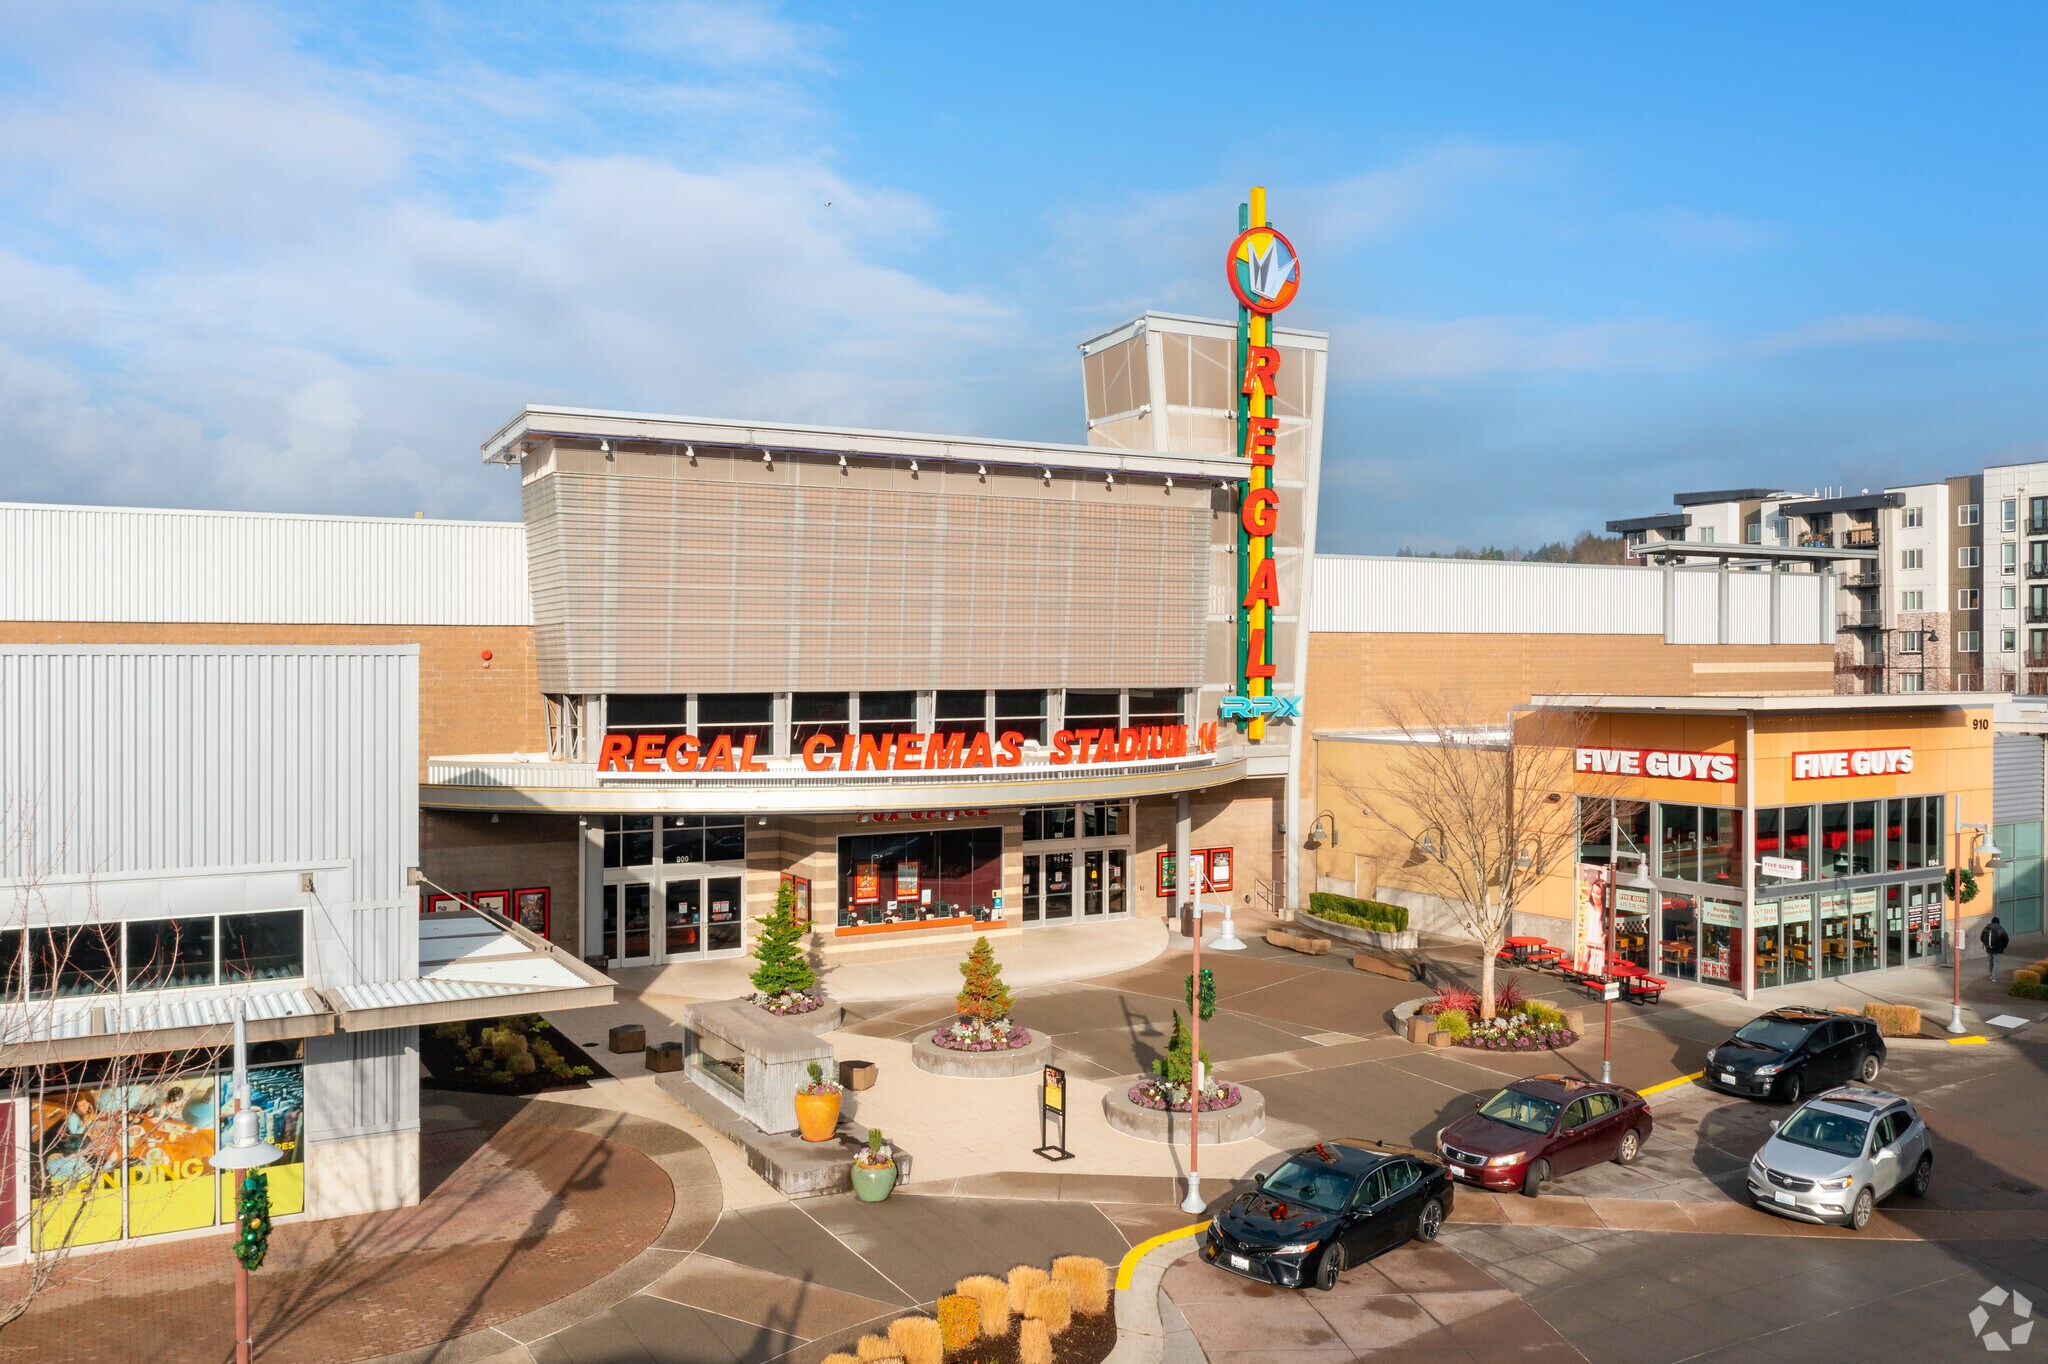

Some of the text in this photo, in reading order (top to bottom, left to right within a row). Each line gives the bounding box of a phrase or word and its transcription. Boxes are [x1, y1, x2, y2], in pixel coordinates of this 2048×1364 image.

[1242, 346, 1280, 679] REGAL
[1221, 696, 1302, 719] RPX
[1972, 718, 1989, 730] 910
[597, 721, 1217, 772] REGAL CINEMAS STADIUM 14
[1576, 748, 1735, 781] FIVE GUYS
[1795, 748, 1914, 779] FIVE GUYS
[1619, 893, 1648, 903] FIVE GUYS
